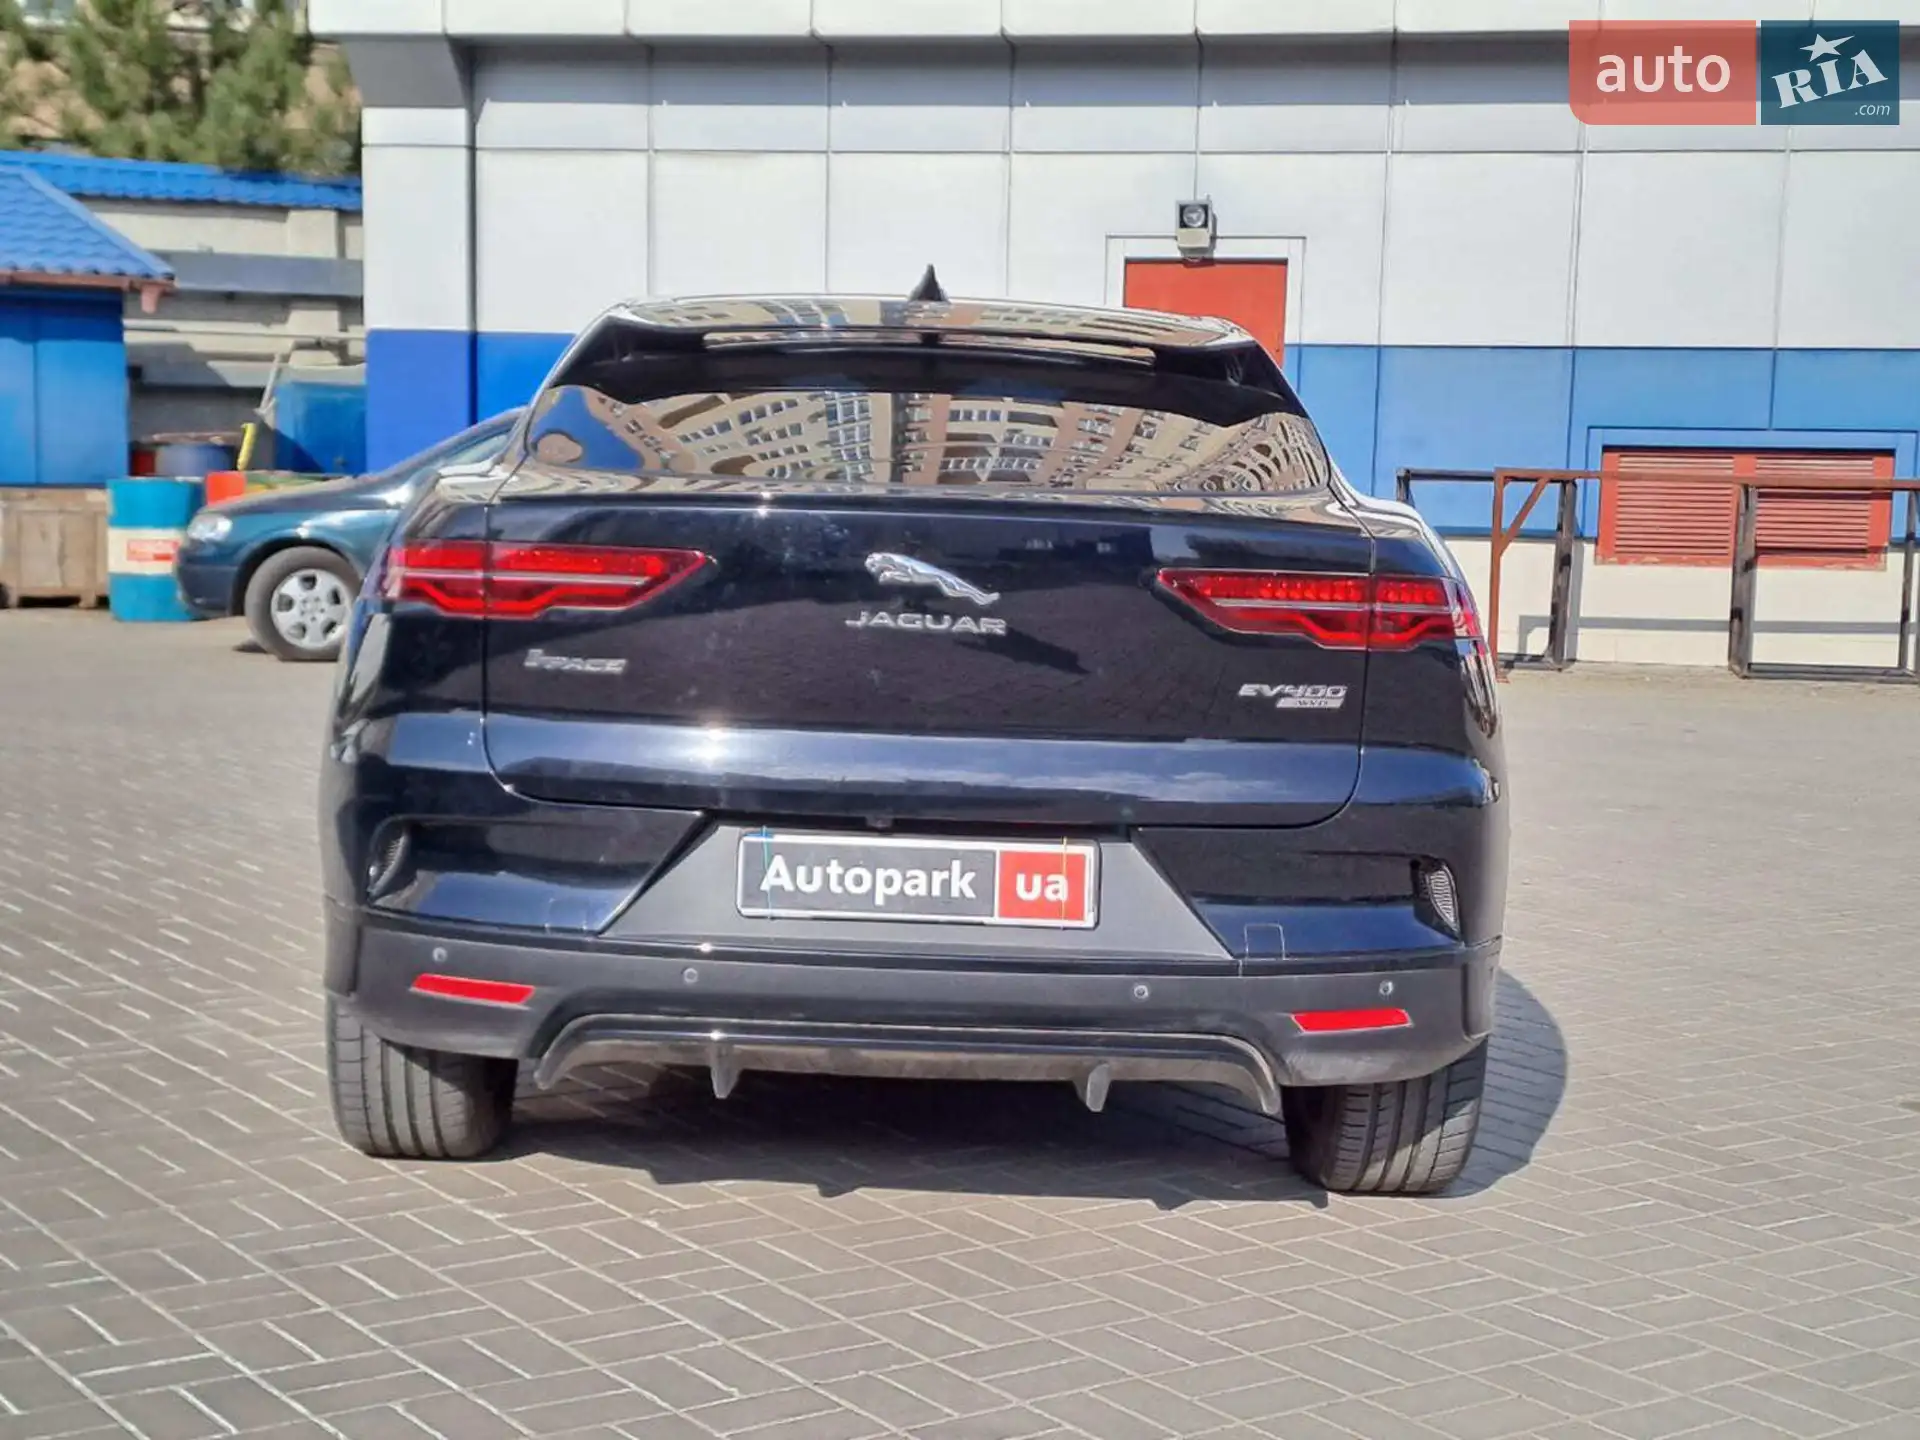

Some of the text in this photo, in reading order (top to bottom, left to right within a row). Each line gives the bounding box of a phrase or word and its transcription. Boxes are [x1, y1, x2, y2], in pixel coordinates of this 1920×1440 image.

[845, 611, 1007, 636] JAGUAR
[1238, 683, 1348, 698] EV400
[759, 854, 1069, 906] Autopark ua
